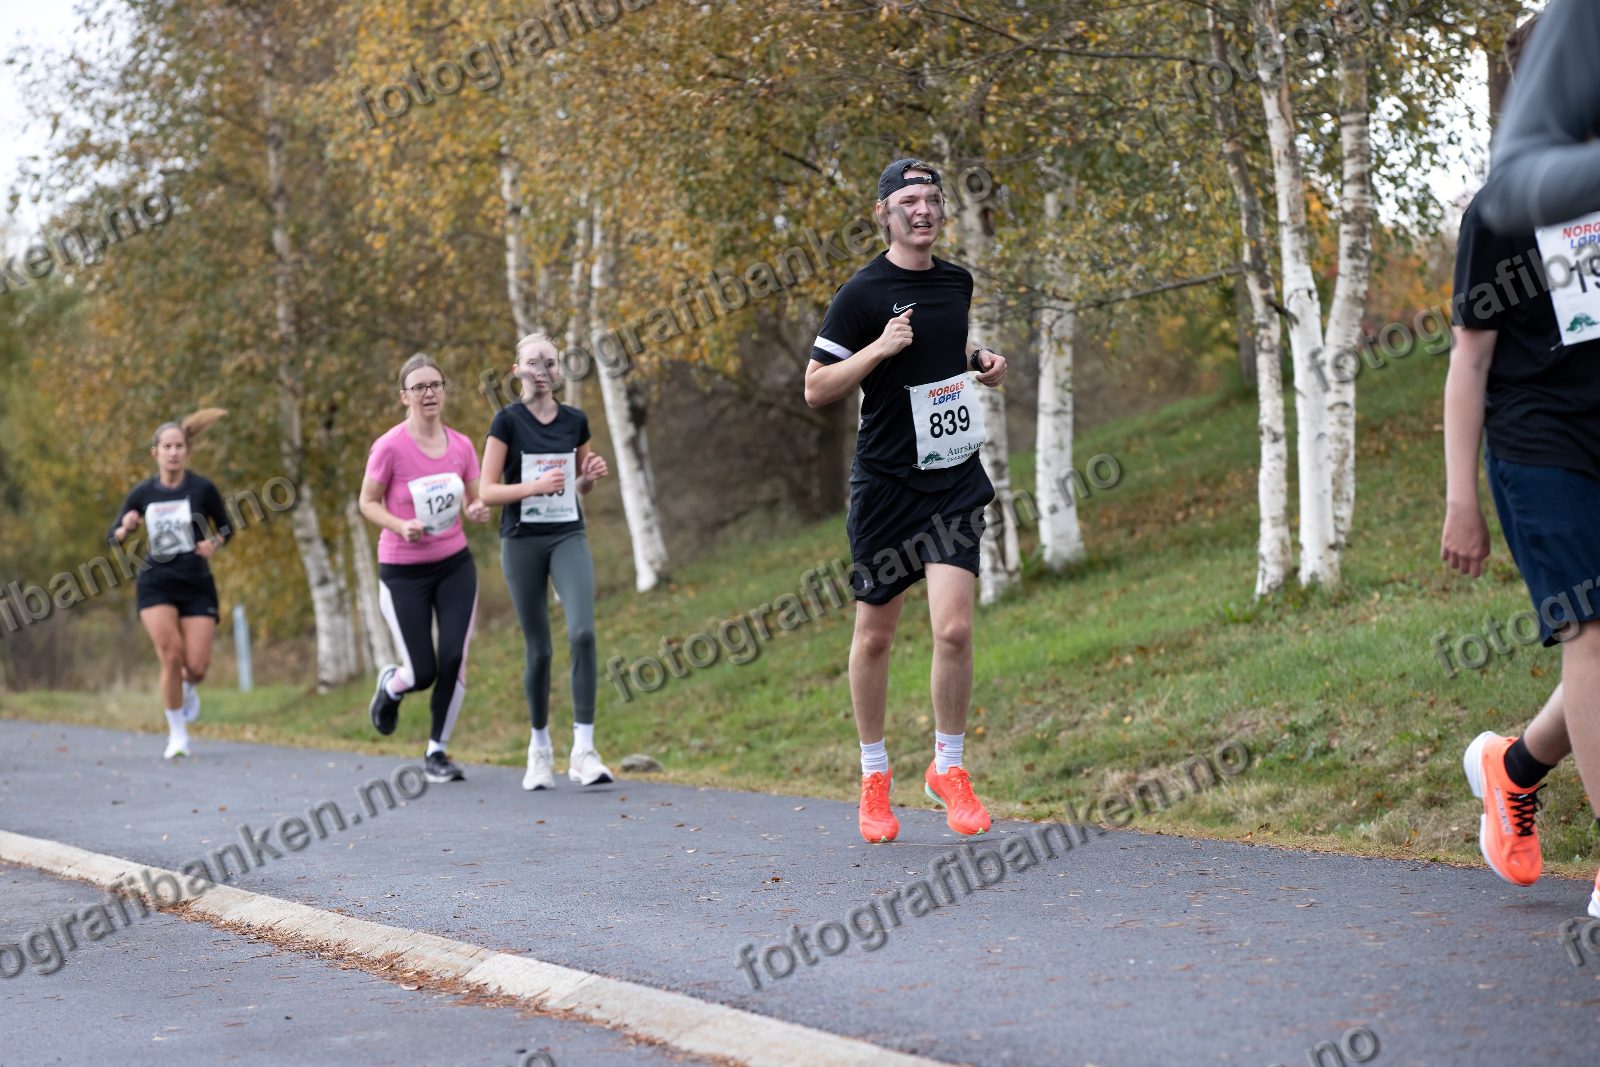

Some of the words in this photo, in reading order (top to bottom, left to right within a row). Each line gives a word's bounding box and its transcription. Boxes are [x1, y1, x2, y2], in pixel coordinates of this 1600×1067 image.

[927, 381, 965, 398] NORGES
[932, 391, 961, 406] LØPET
[929, 405, 971, 439] 839
[426, 492, 455, 515] 122
